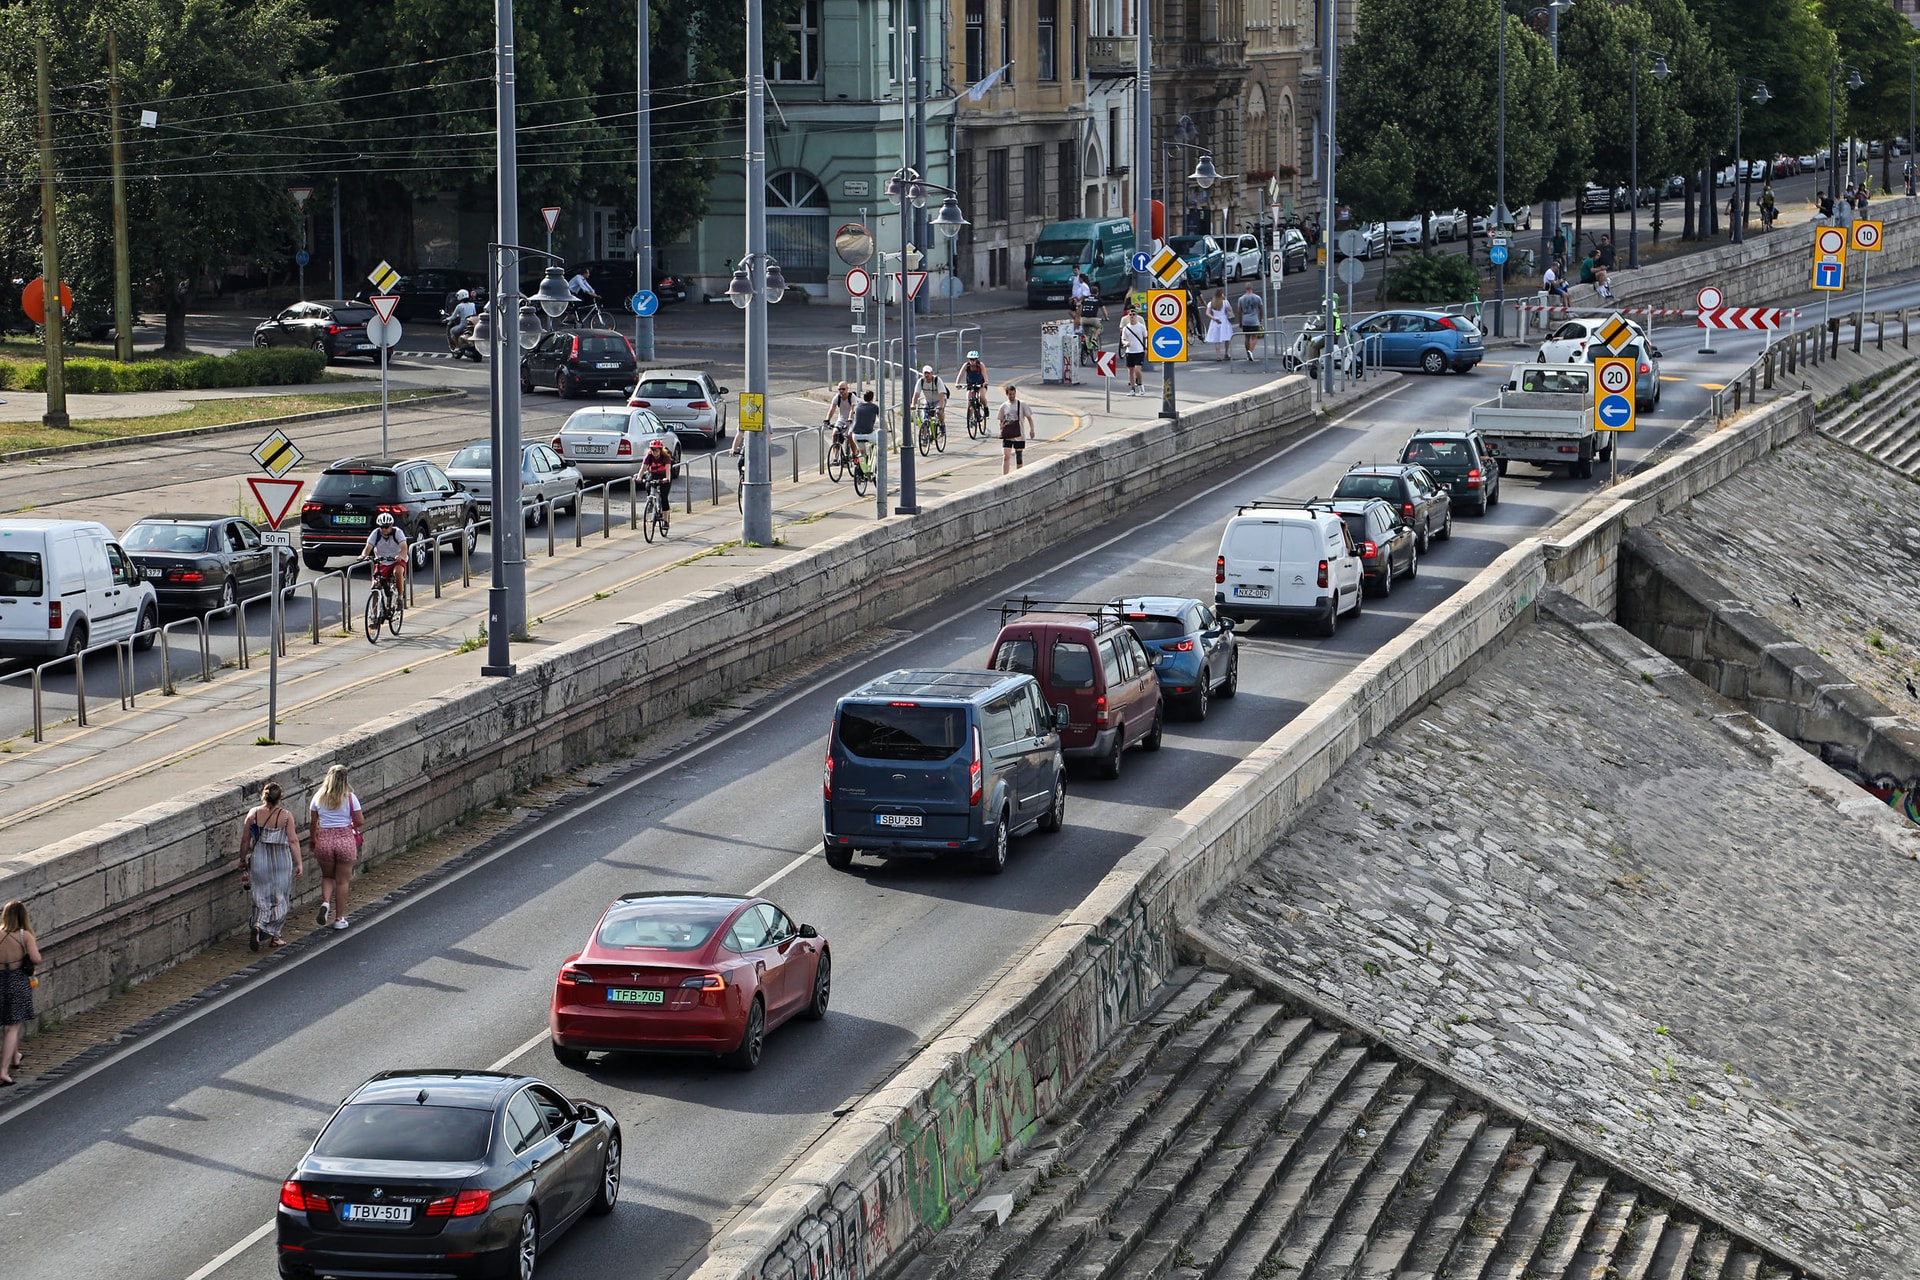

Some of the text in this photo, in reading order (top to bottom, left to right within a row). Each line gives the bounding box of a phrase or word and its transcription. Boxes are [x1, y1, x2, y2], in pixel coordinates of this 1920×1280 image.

[1862, 231, 1873, 241] 10
[1159, 303, 1175, 316] 20
[1607, 371, 1623, 384] 20
[265, 534, 275, 543] 50
[882, 815, 921, 826] SBU-253
[615, 990, 661, 1002] TFB-705
[353, 1205, 408, 1220] TBV-501
